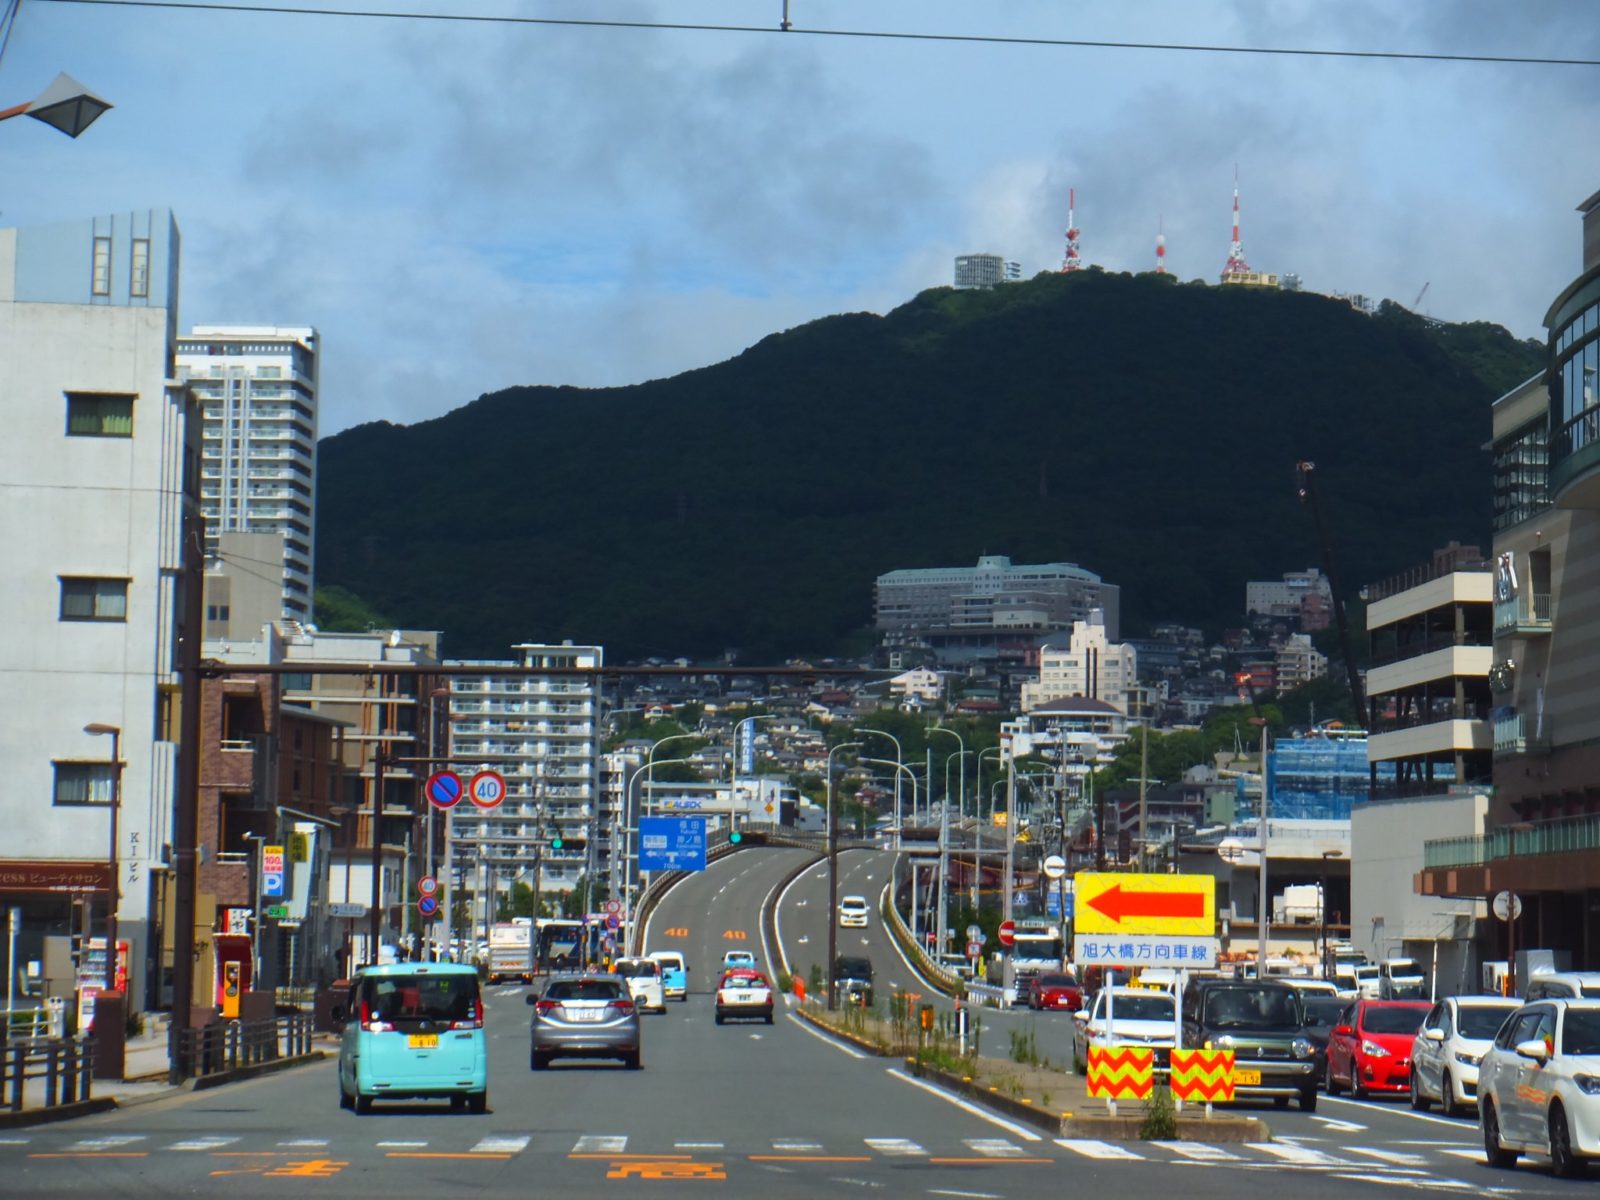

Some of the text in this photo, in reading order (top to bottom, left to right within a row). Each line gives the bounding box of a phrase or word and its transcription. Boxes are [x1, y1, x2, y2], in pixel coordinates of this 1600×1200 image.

[477, 782, 497, 798] 40
[664, 927, 688, 937] 40
[723, 930, 747, 939] 40
[1083, 942, 1208, 961] 旭大橋方向車線
